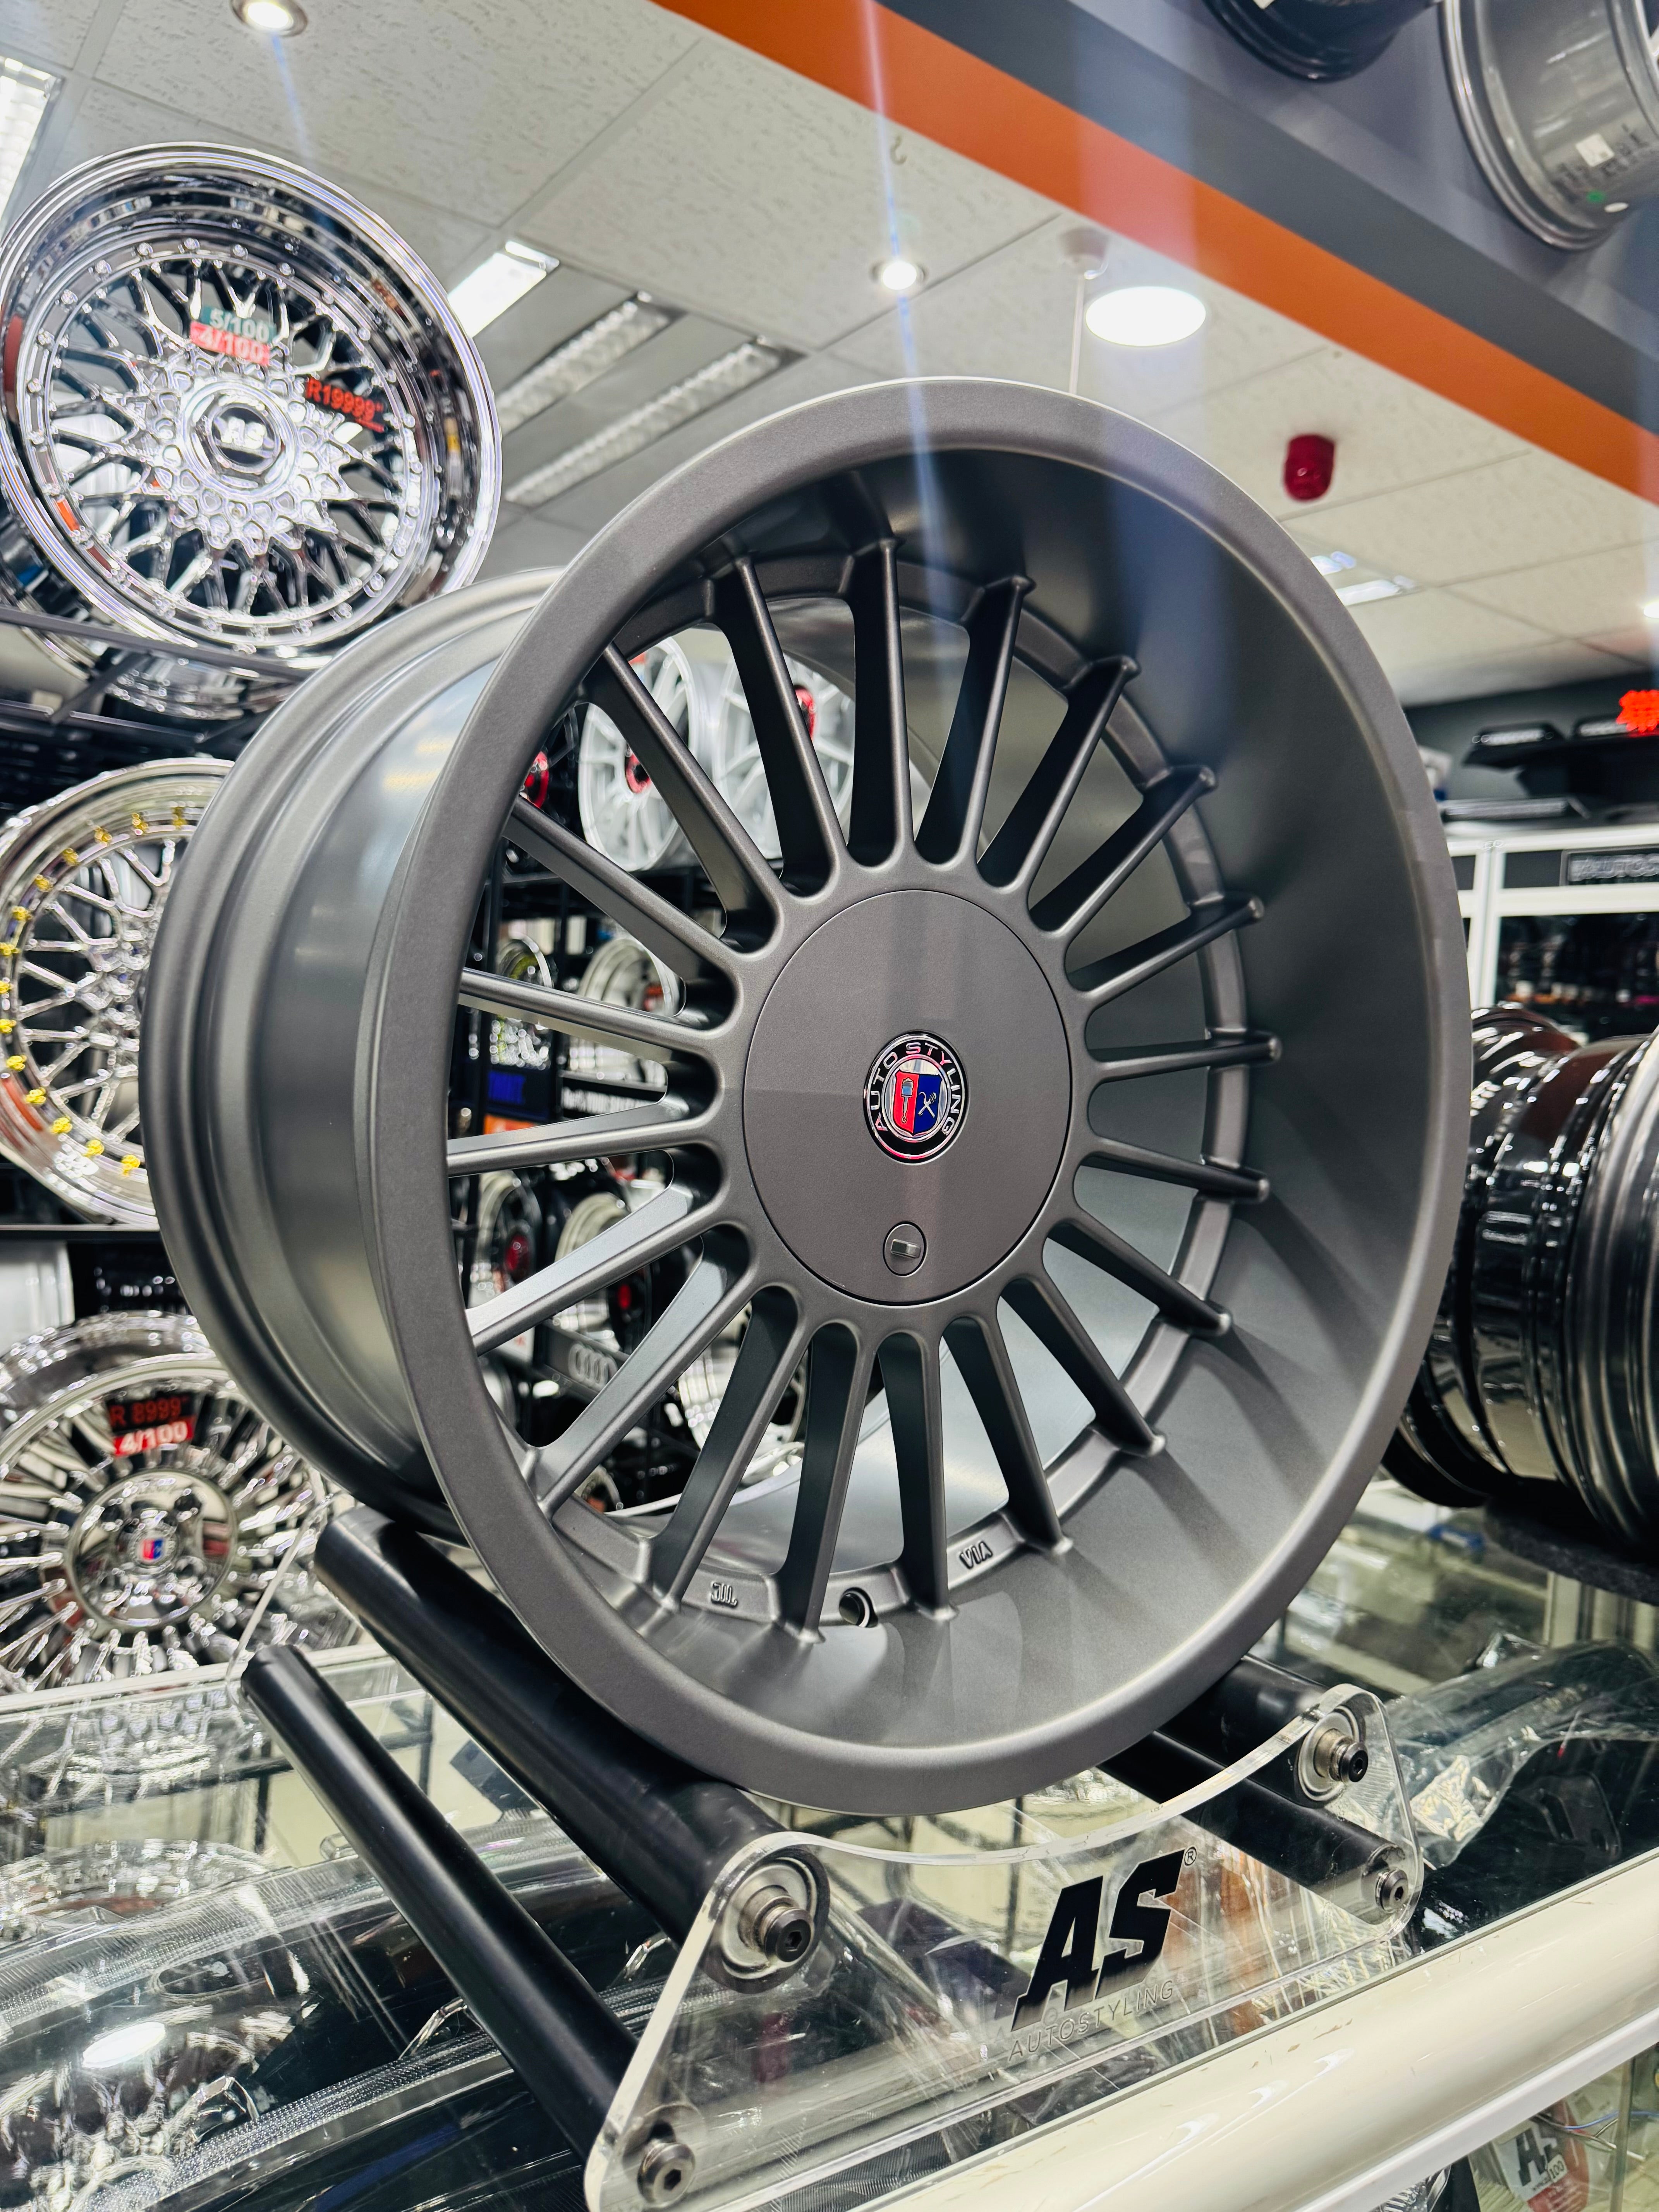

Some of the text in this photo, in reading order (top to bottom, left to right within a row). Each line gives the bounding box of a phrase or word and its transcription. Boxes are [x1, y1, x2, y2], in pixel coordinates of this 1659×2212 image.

[210, 308, 269, 345] 5/100
[199, 328, 264, 362] 4/100
[871, 1042, 961, 1136] AUTO STYLING
[110, 1405, 126, 1427] R
[119, 1420, 189, 1453] 4/100
[959, 1541, 993, 1570] VIA
[1008, 1980, 1174, 2062] AUTOSTYLING
